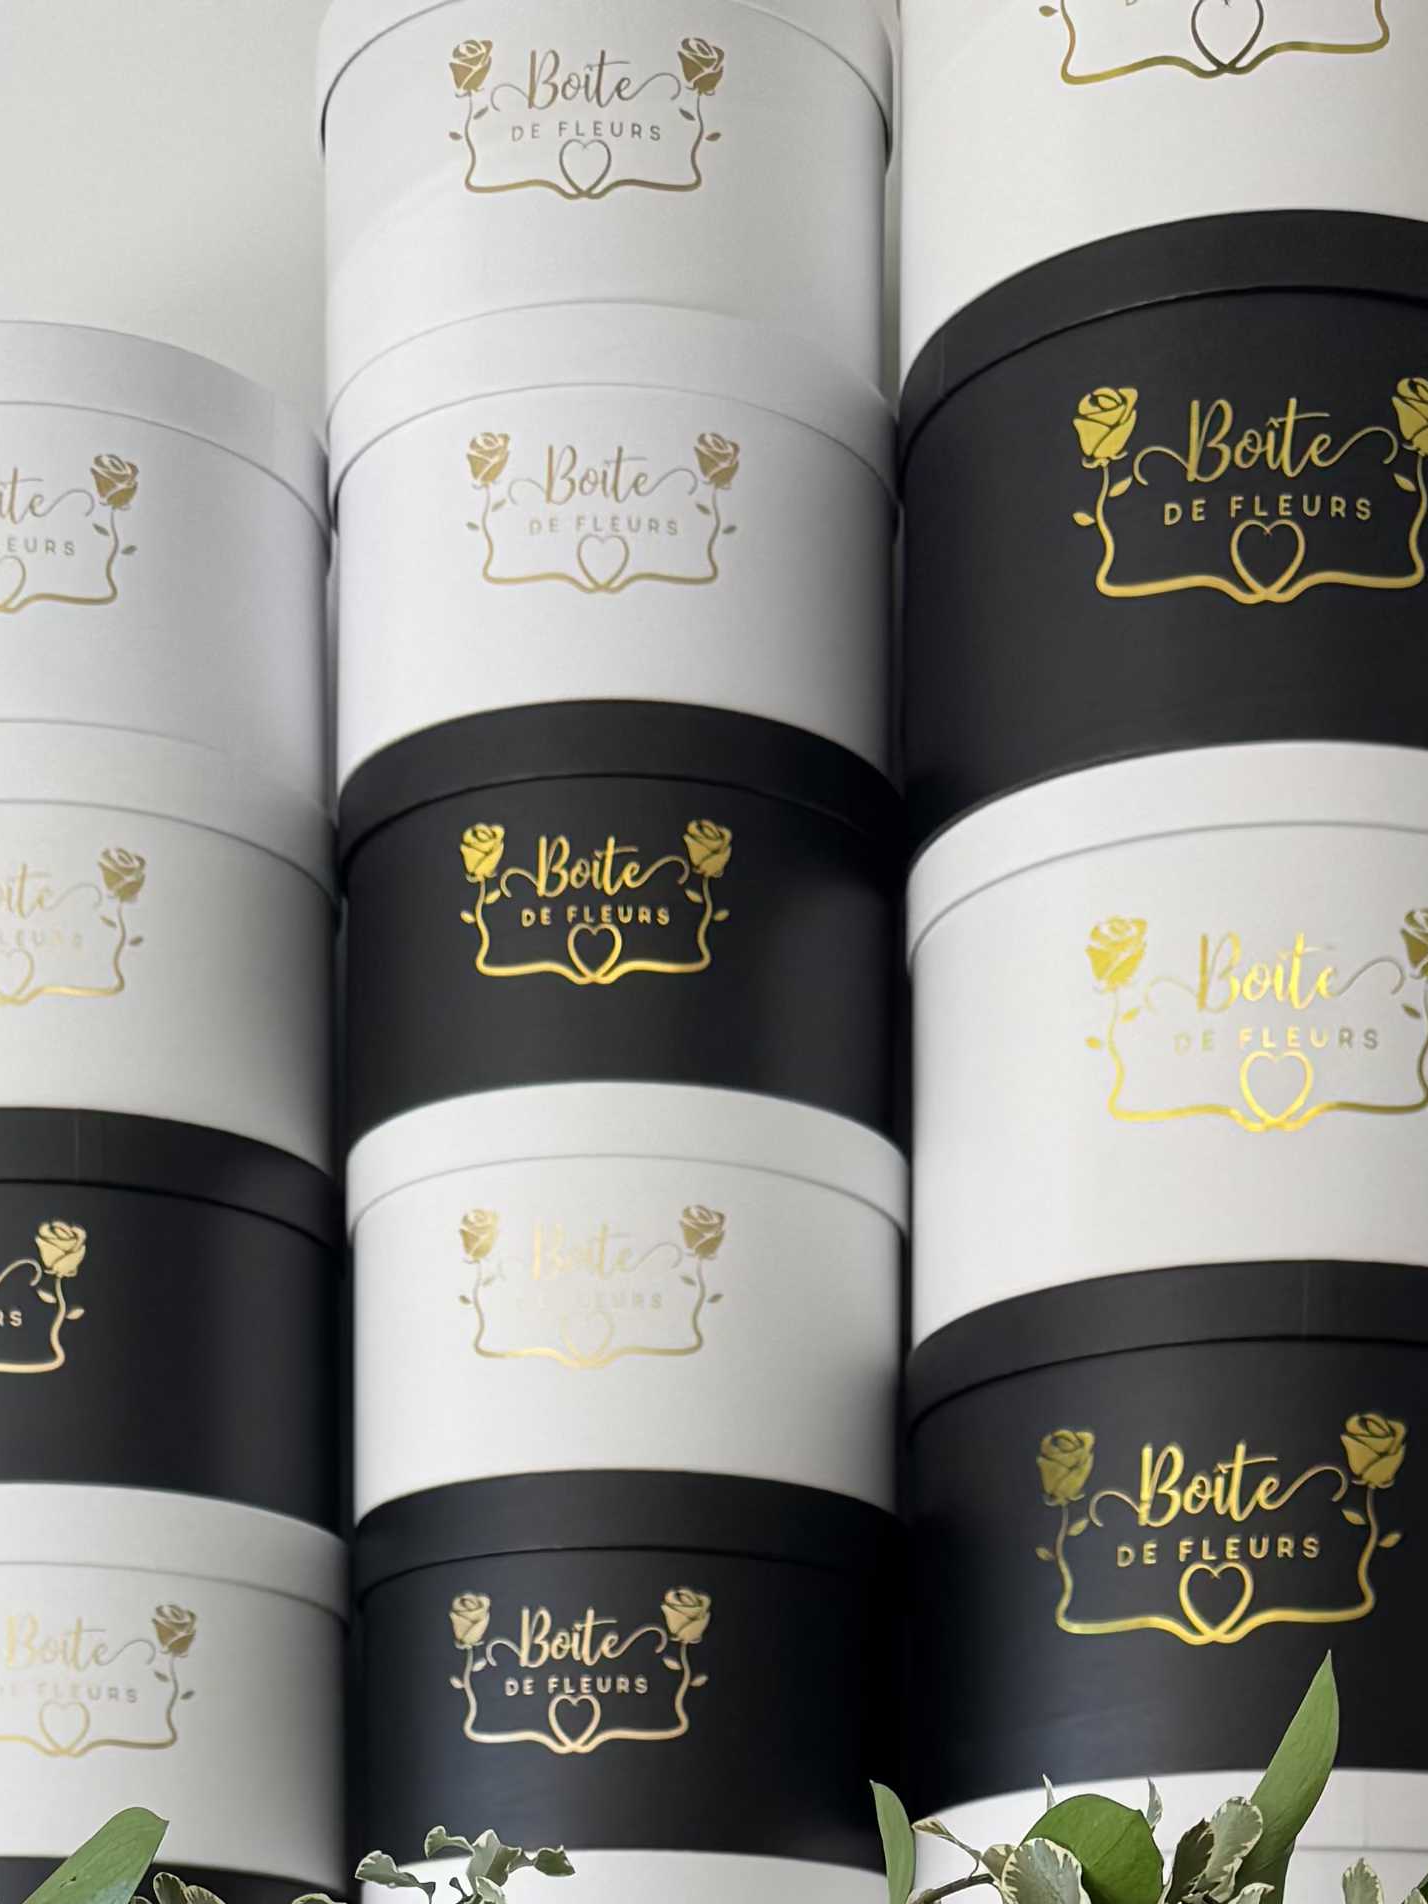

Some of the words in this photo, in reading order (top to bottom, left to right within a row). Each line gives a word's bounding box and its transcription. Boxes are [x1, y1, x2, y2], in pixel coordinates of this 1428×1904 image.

[512, 124, 544, 142] DE
[558, 120, 662, 142] FLEURS
[1163, 499, 1208, 527] DE
[1230, 494, 1374, 523] FLEURS
[528, 519, 560, 537] DE
[576, 516, 680, 537] FLEURS
[522, 907, 553, 926] DE
[567, 905, 670, 926] FLEURS
[1174, 1030, 1214, 1053] DE
[1238, 1028, 1380, 1051] FLEURS
[1117, 1540, 1158, 1567] DE
[1178, 1536, 1321, 1562] FLEURS
[506, 1677, 535, 1697] DE
[548, 1674, 649, 1695] FLEURS
